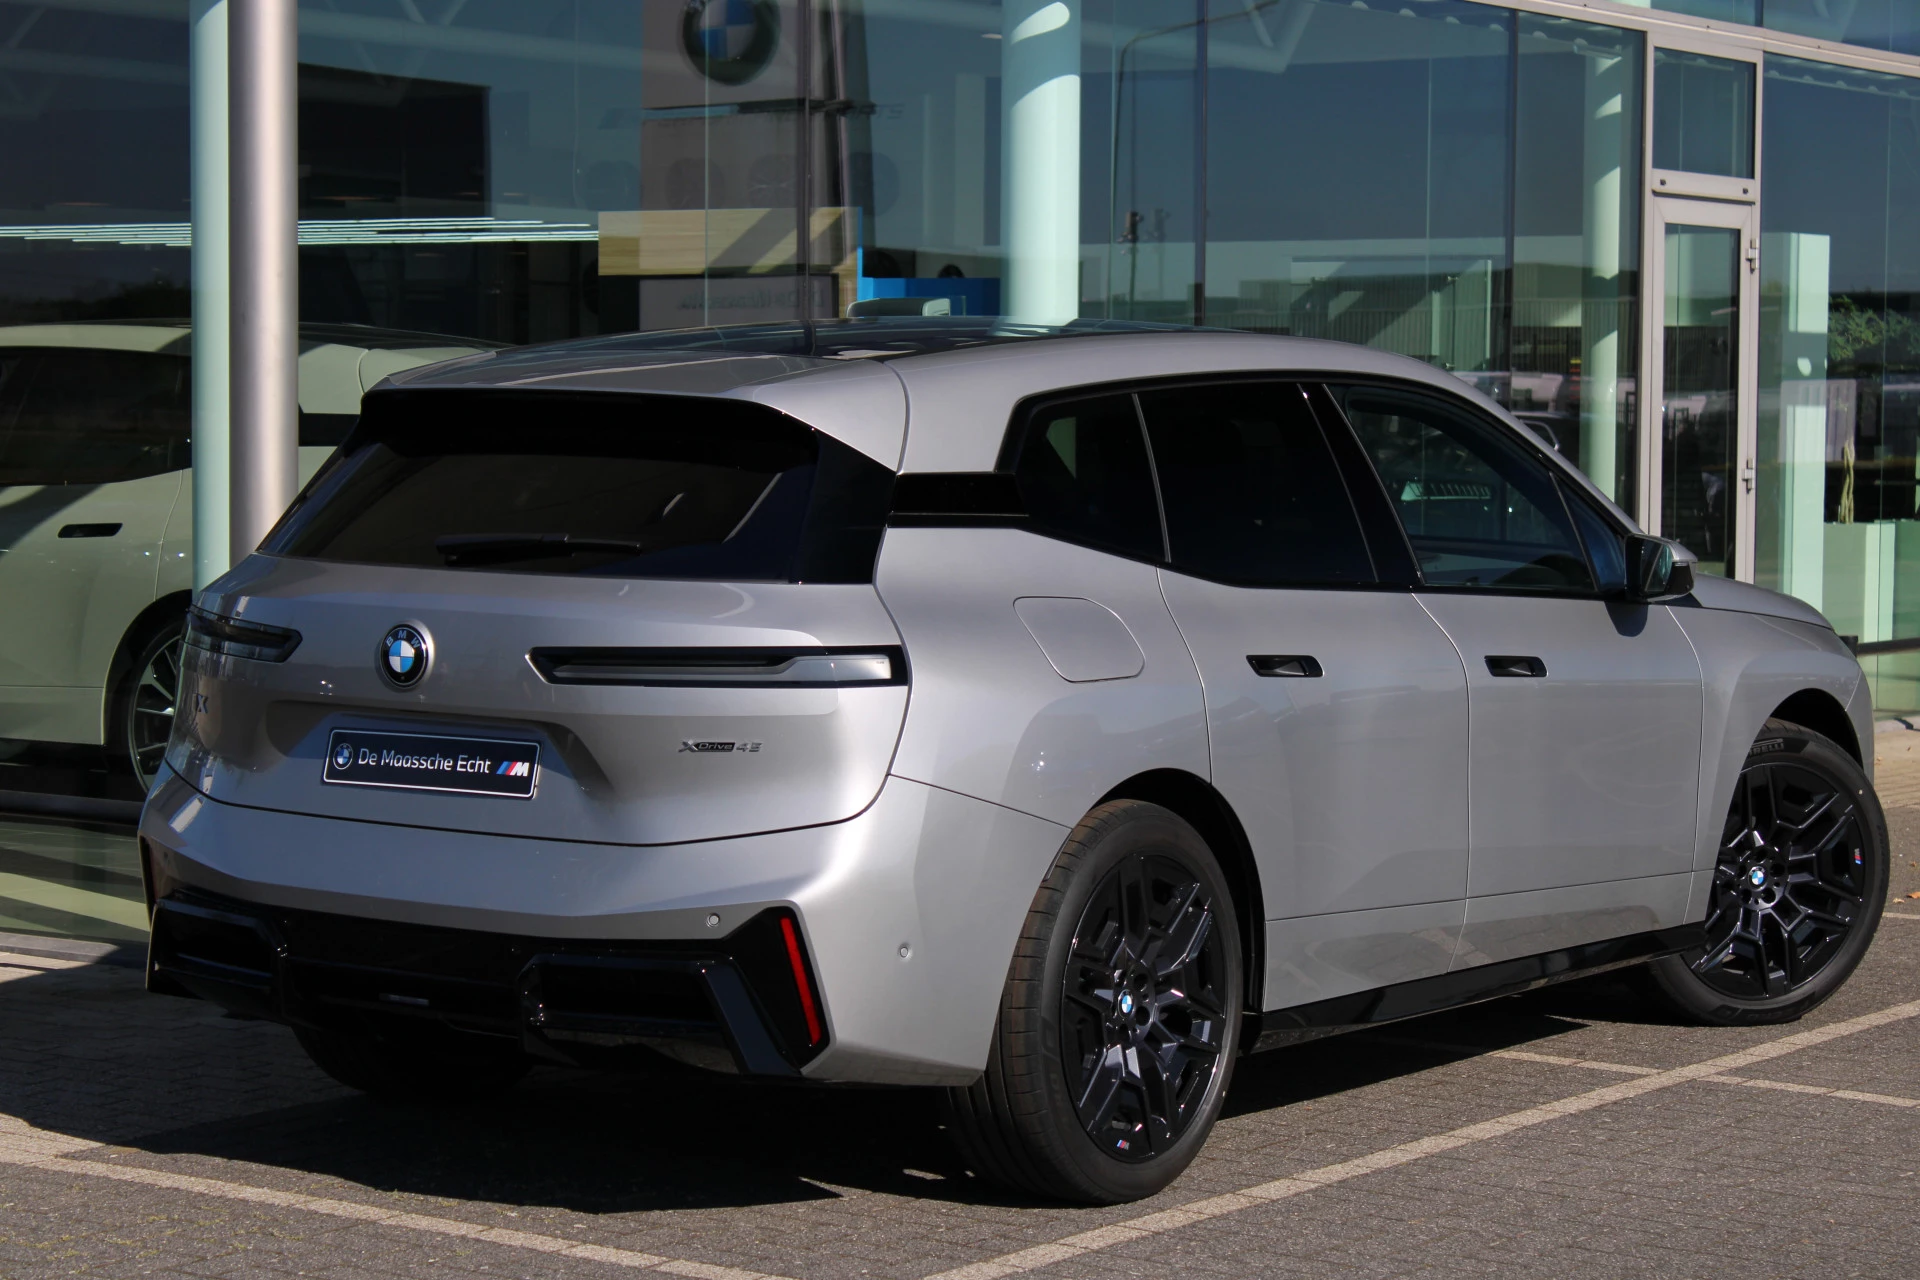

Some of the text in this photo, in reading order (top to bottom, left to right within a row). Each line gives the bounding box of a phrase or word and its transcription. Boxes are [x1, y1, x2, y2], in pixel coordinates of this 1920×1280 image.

[385, 630, 421, 648] BMW
[1750, 738, 1785, 757] IRELLI
[358, 748, 378, 766] De
[380, 749, 453, 771] Maassche
[456, 754, 491, 774] Echt
